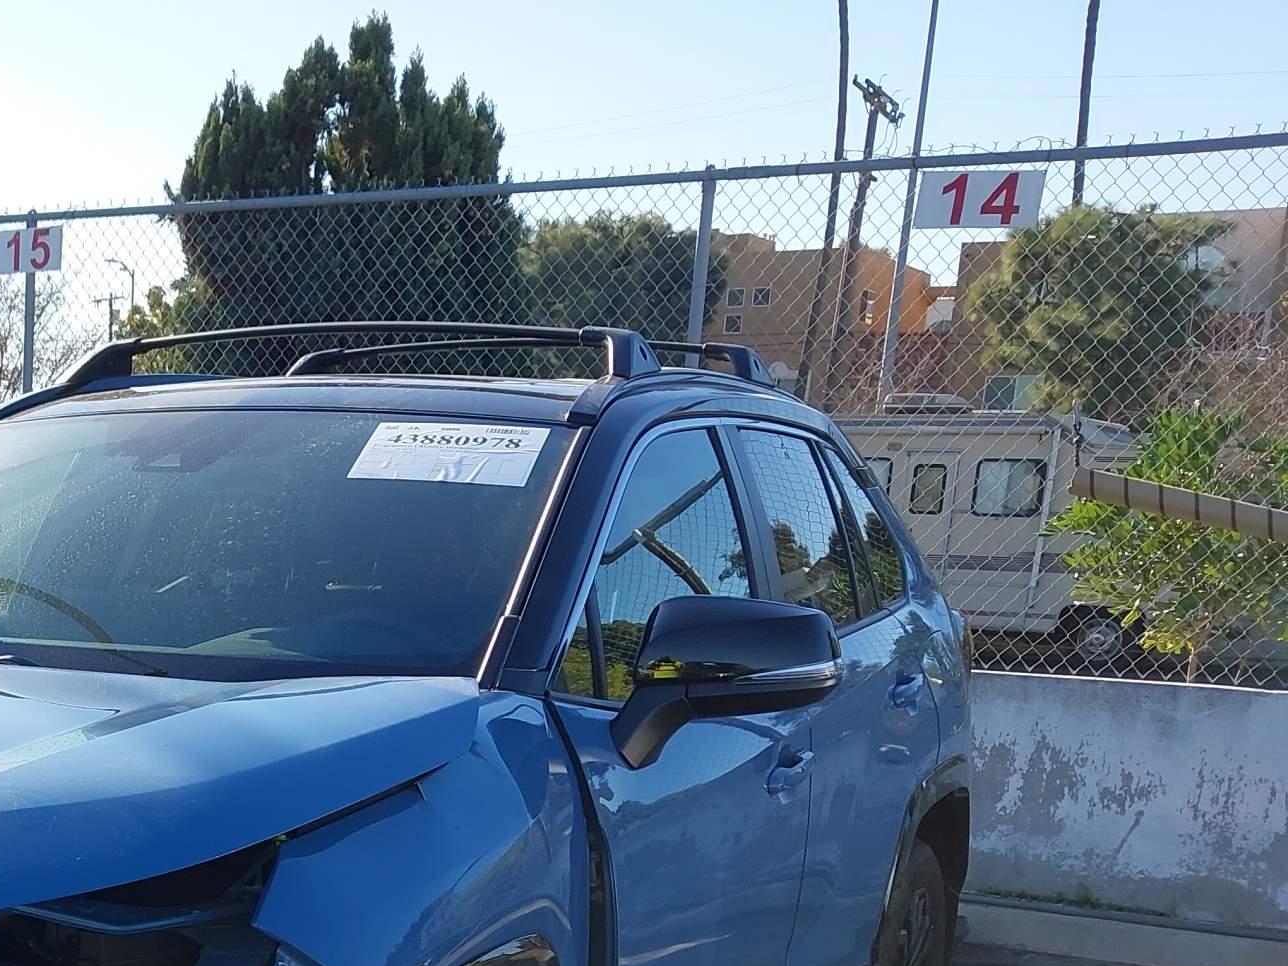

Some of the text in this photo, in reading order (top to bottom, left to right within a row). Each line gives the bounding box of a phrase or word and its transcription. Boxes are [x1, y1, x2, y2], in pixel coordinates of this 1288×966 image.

[942, 172, 1021, 225] 14
[7, 228, 50, 272] 15
[386, 433, 523, 449] 43880978
